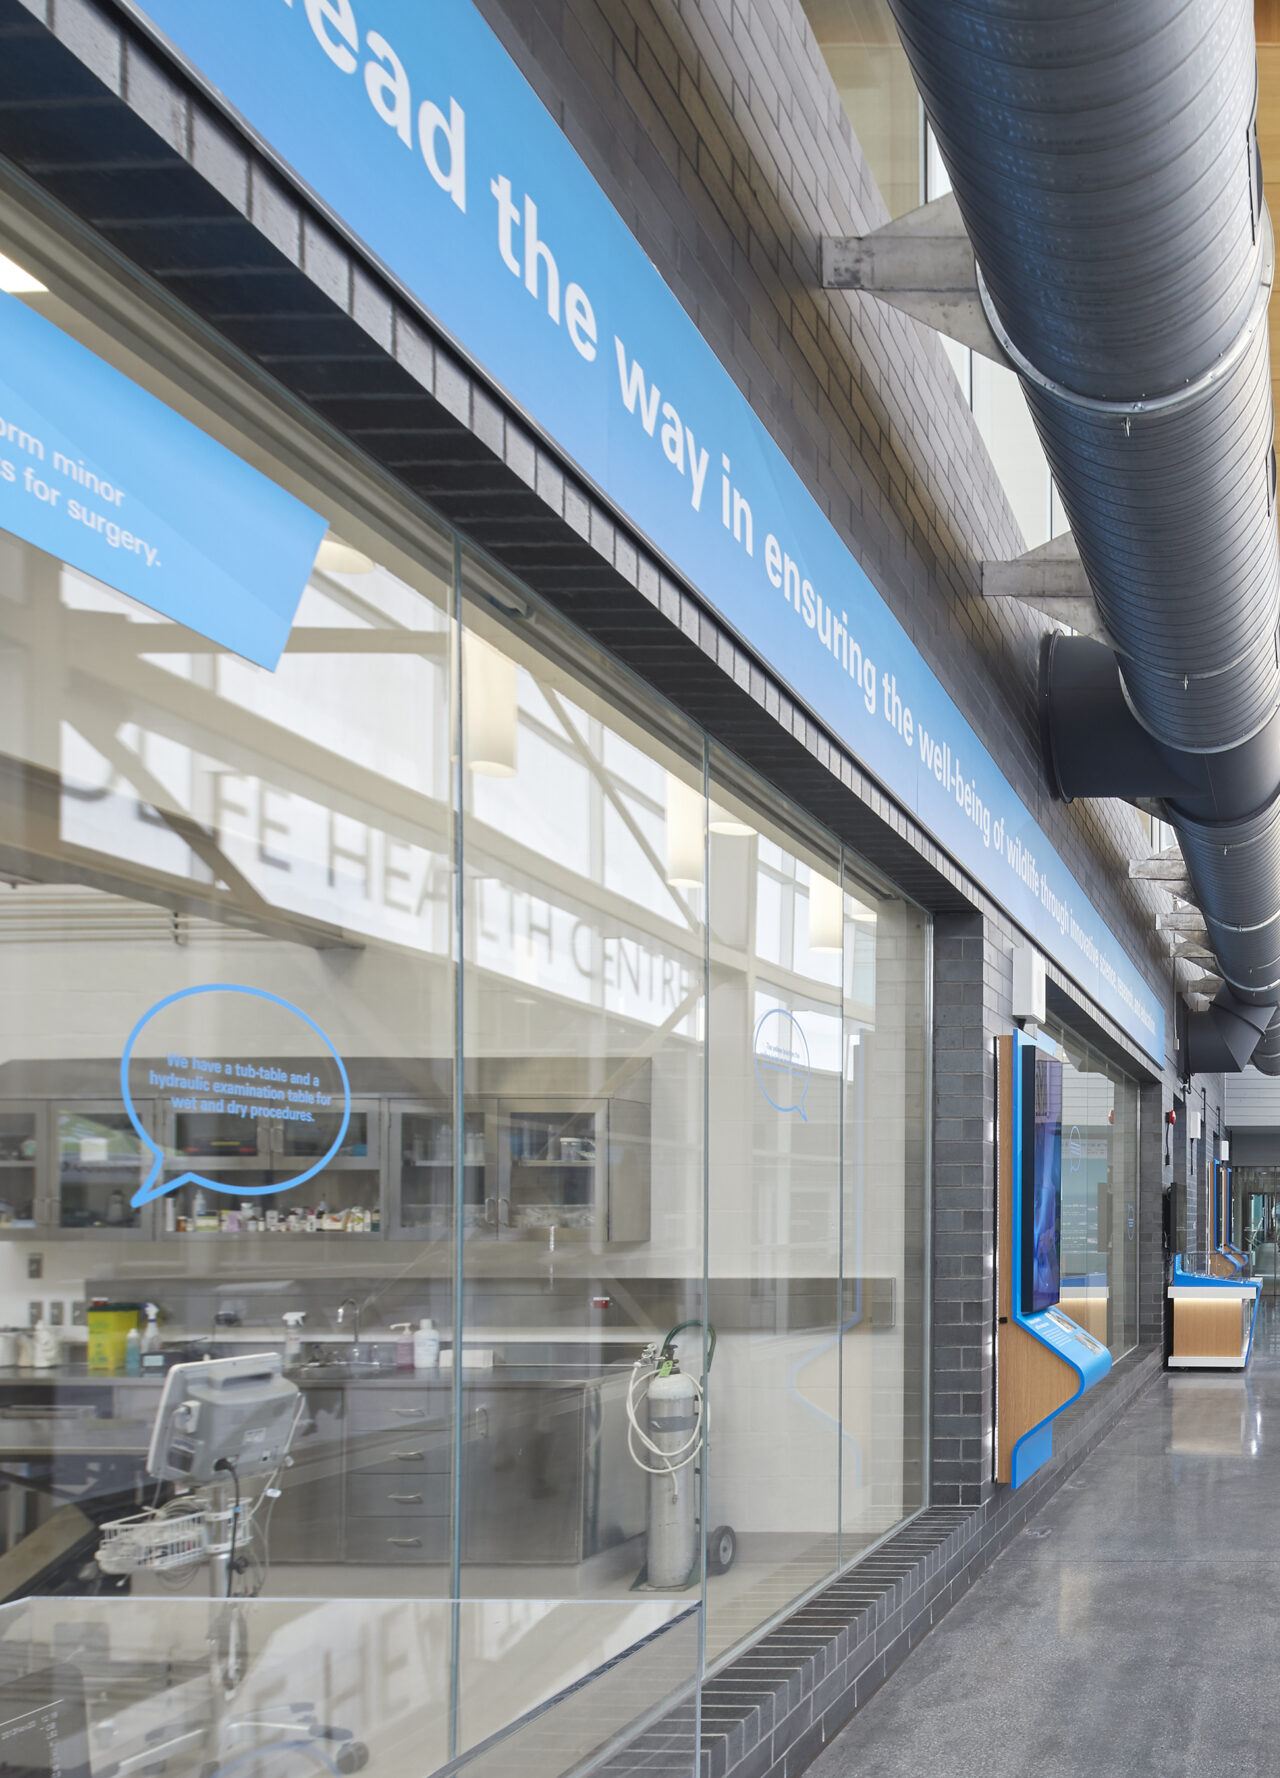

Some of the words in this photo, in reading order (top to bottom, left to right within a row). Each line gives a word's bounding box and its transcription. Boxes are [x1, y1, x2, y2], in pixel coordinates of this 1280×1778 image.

[53, 451, 126, 507] minor
[284, 0, 466, 214] ead
[490, 174, 598, 363] the
[614, 334, 709, 512] way
[722, 453, 754, 557] in
[764, 534, 877, 715] ensuring
[882, 673, 914, 747] the
[918, 723, 991, 848] well-being
[993, 817, 1006, 855] of
[1006, 835, 1040, 897] wildlife
[1040, 874, 1070, 935] through
[23, 467, 61, 506] for
[67, 499, 162, 567] surgery.
[149, 1070, 210, 1091] hydraulic
[212, 1082, 285, 1101] examination
[287, 1089, 316, 1105] table
[316, 1092, 331, 1106] for
[167, 1052, 189, 1069] We
[192, 1056, 221, 1074] have
[224, 1062, 233, 1075] a
[235, 1063, 288, 1083] tub-table
[289, 1073, 311, 1086] and
[312, 1076, 320, 1087] a
[171, 1096, 197, 1110] wet
[199, 1099, 225, 1112] and
[226, 1100, 248, 1119] dry
[249, 1105, 316, 1122] procedures.
